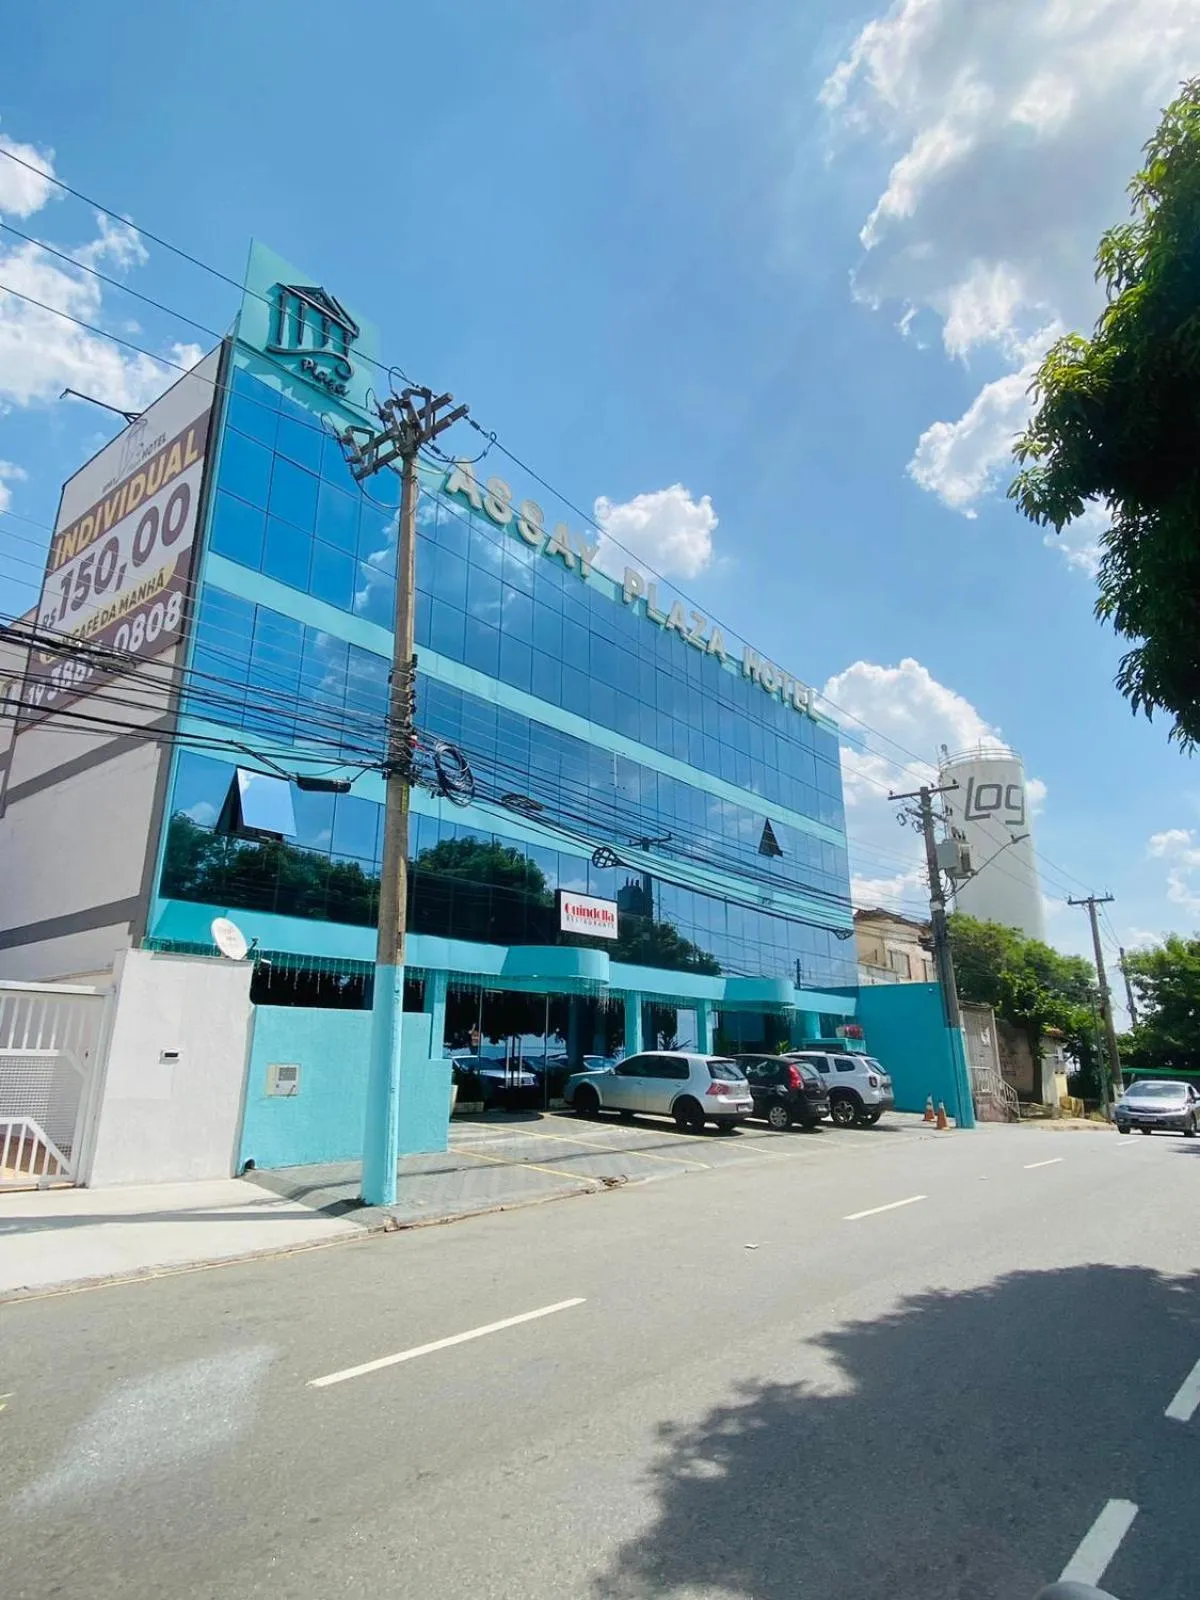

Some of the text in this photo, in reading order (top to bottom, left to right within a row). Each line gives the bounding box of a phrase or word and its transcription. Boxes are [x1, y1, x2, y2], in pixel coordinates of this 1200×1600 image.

[54, 429, 198, 568] INDIVIDUAL
[58, 482, 191, 621] 150,00
[100, 603, 117, 624] DA
[444, 457, 823, 722] ASSAY PLAZA HOTEL
